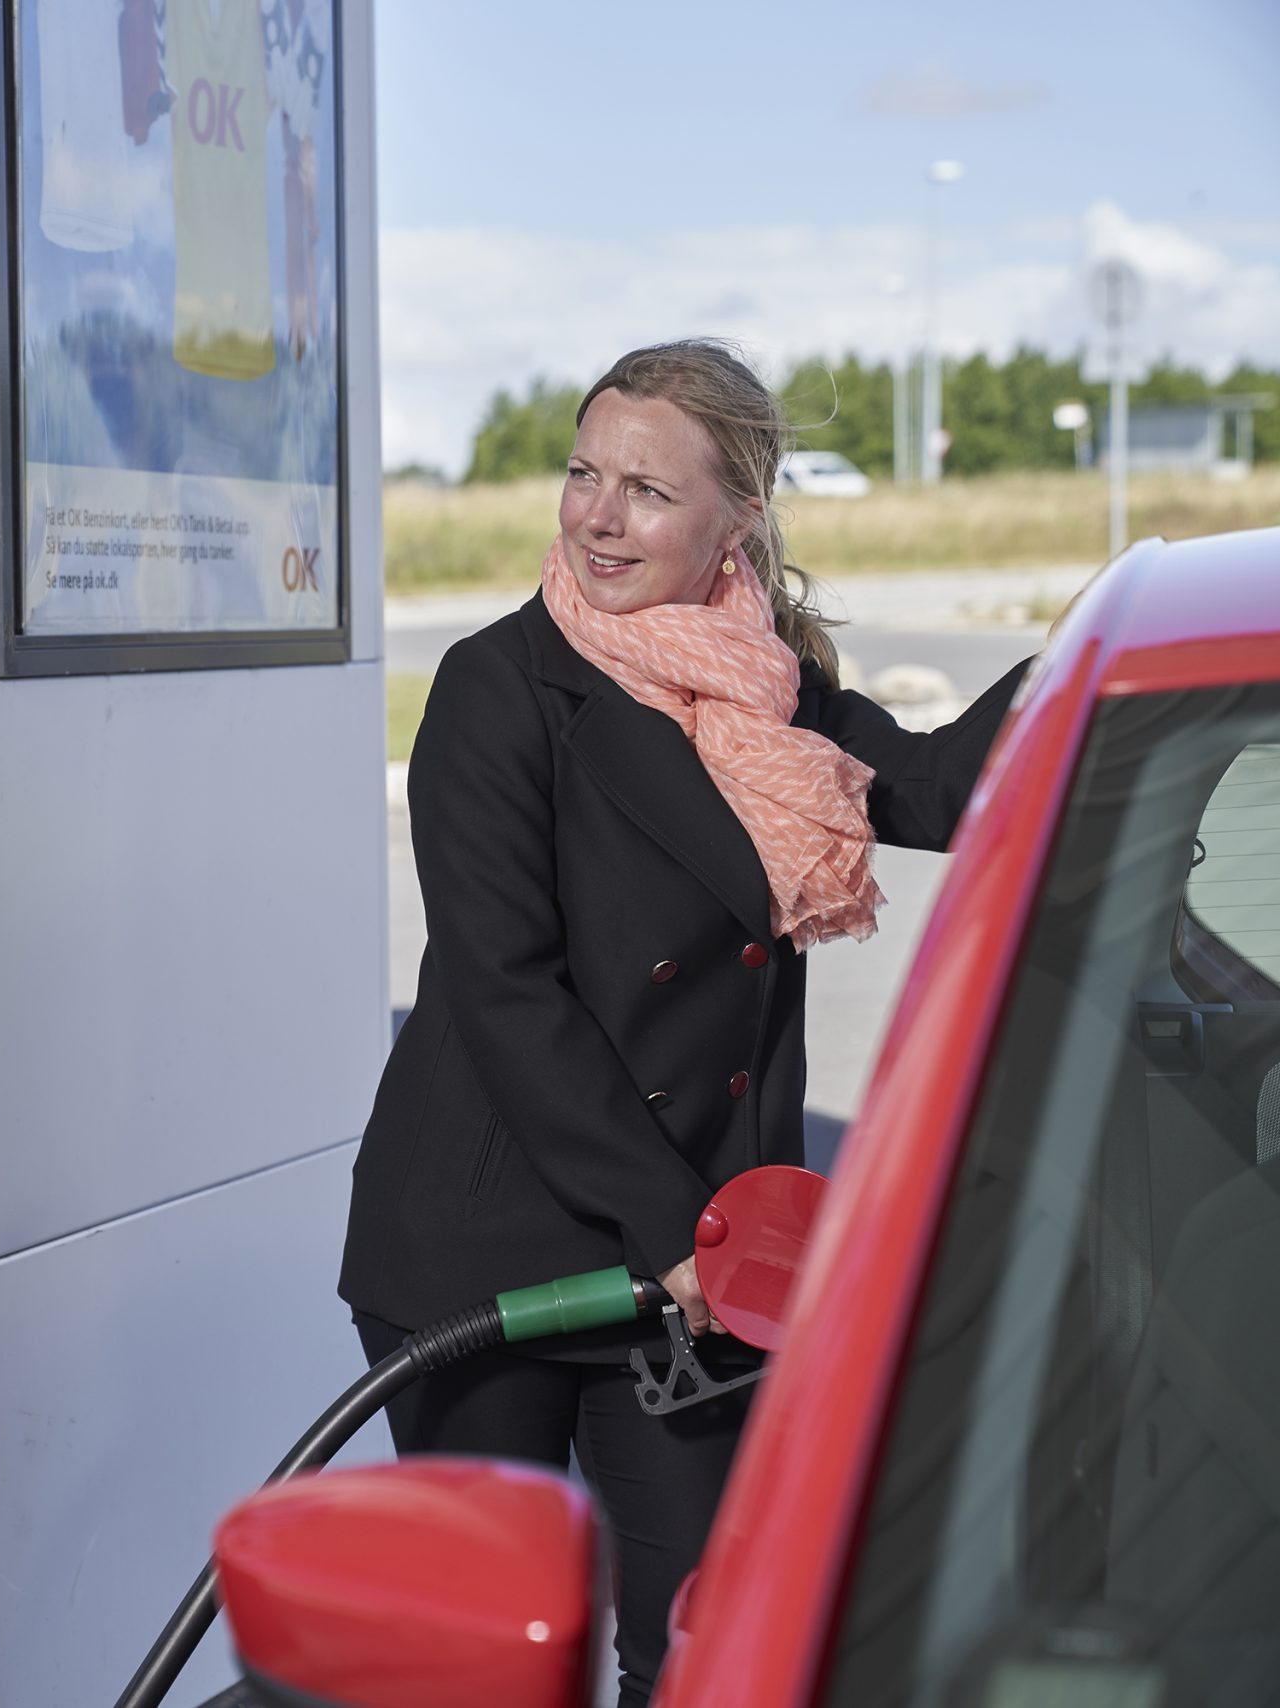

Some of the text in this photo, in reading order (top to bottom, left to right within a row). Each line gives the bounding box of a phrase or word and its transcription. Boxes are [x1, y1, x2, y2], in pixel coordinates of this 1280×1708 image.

[187, 77, 247, 152] OK
[68, 508, 81, 527] OK
[83, 509, 130, 530] Benzinkort,
[57, 536, 71, 555] kan
[73, 536, 84, 555] du
[46, 569, 118, 593] Se mere på ok.dk
[281, 546, 320, 592] OK
